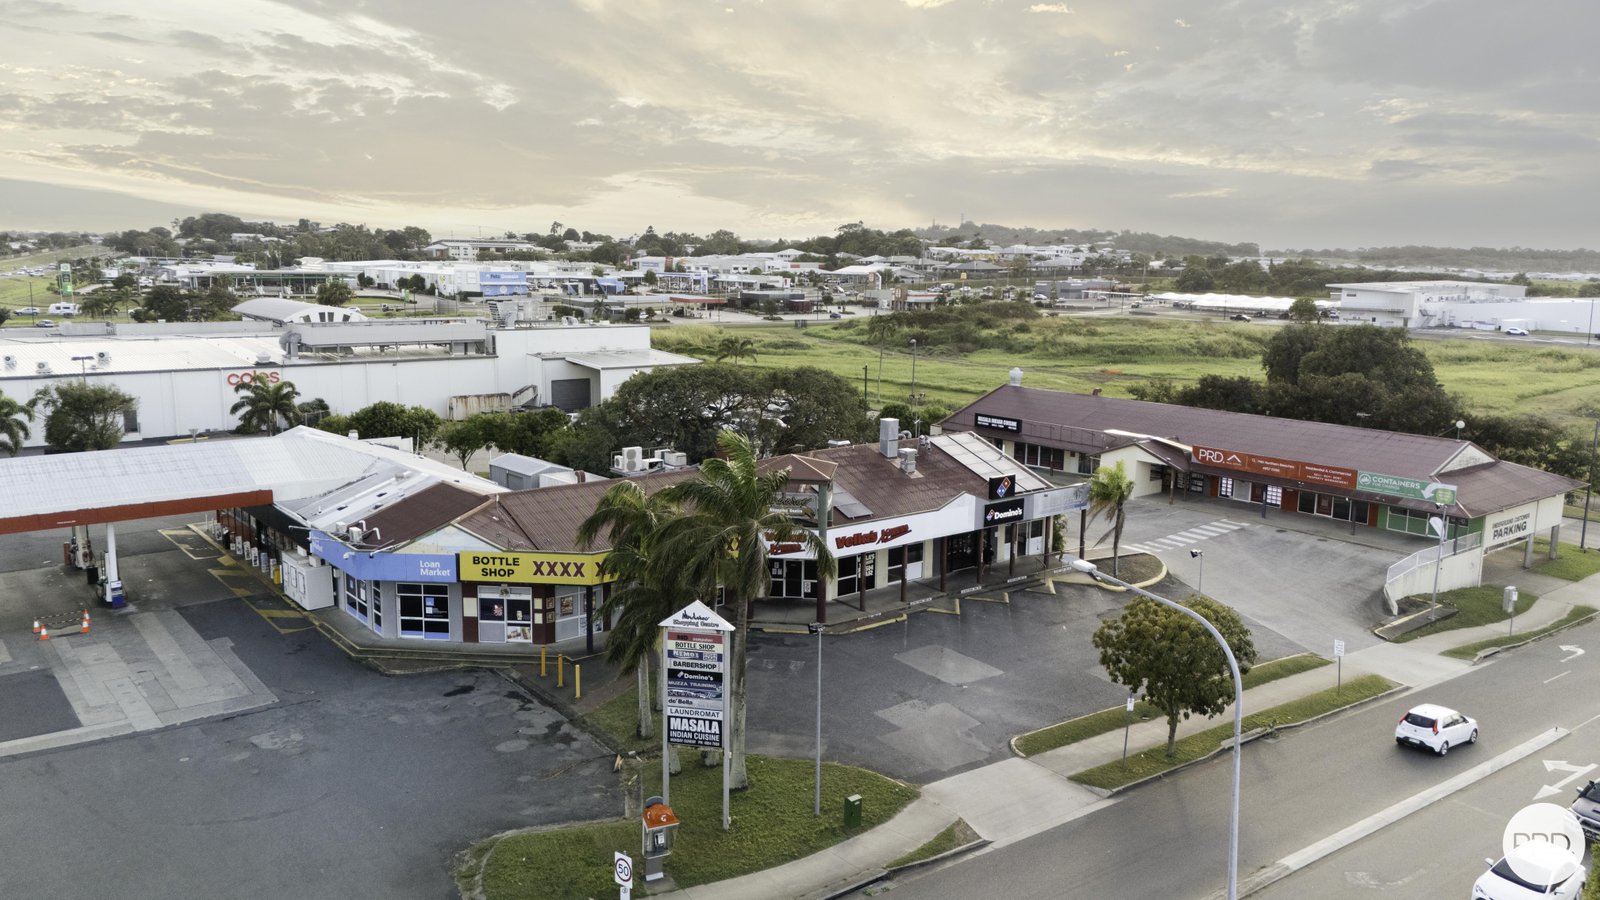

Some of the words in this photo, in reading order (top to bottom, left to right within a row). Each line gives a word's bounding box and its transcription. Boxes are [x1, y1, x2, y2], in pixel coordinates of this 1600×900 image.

[1372, 476, 1420, 489] CONTAINERS
[994, 508, 1023, 519] Domino's
[1493, 521, 1527, 540] PARKING
[419, 560, 441, 568] Loan
[472, 556, 520, 566] BOTTLE
[481, 568, 515, 578] SHOP
[532, 560, 586, 578] XXXX
[675, 641, 697, 649] BOTTLE
[673, 661, 717, 670] BARBERSHOP
[684, 673, 714, 681] Domino's
[670, 708, 720, 718] LAUNDROMAT
[670, 717, 720, 734] MASALA
[670, 730, 692, 739] INDIAN
[693, 733, 720, 742] CUISINE
[618, 863, 629, 877] 50
